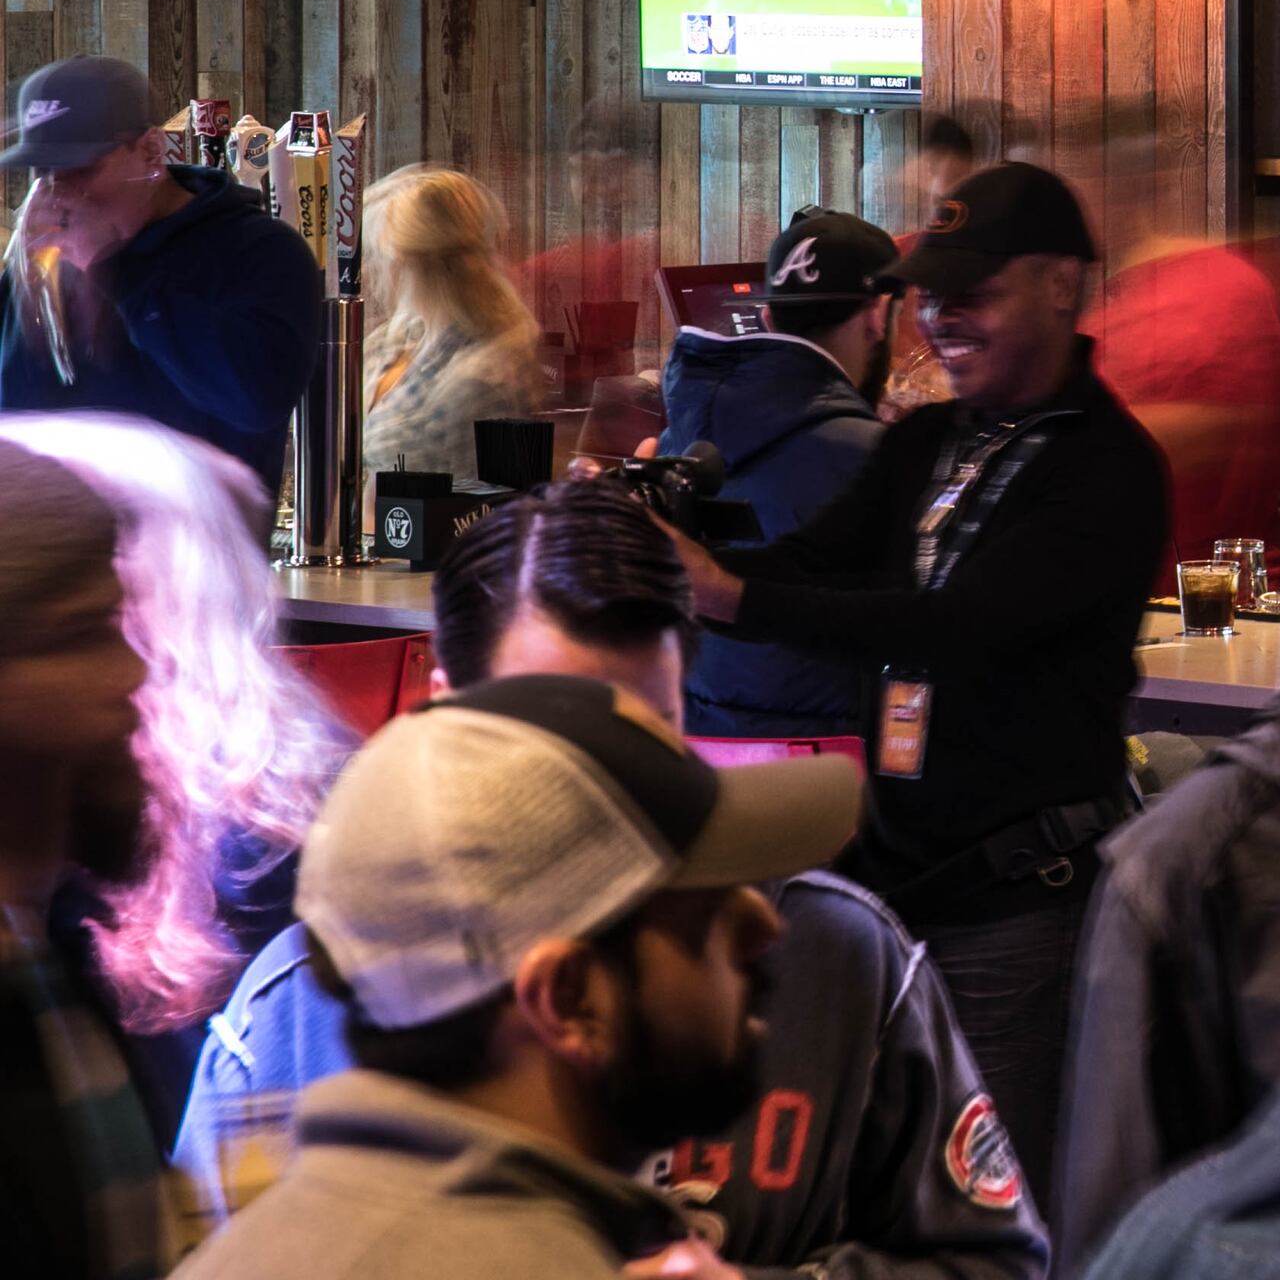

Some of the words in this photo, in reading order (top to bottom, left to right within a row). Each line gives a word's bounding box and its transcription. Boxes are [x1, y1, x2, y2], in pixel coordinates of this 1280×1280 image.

[299, 185, 314, 238] Coors
[771, 236, 820, 287] A
[452, 510, 478, 537] JACK
